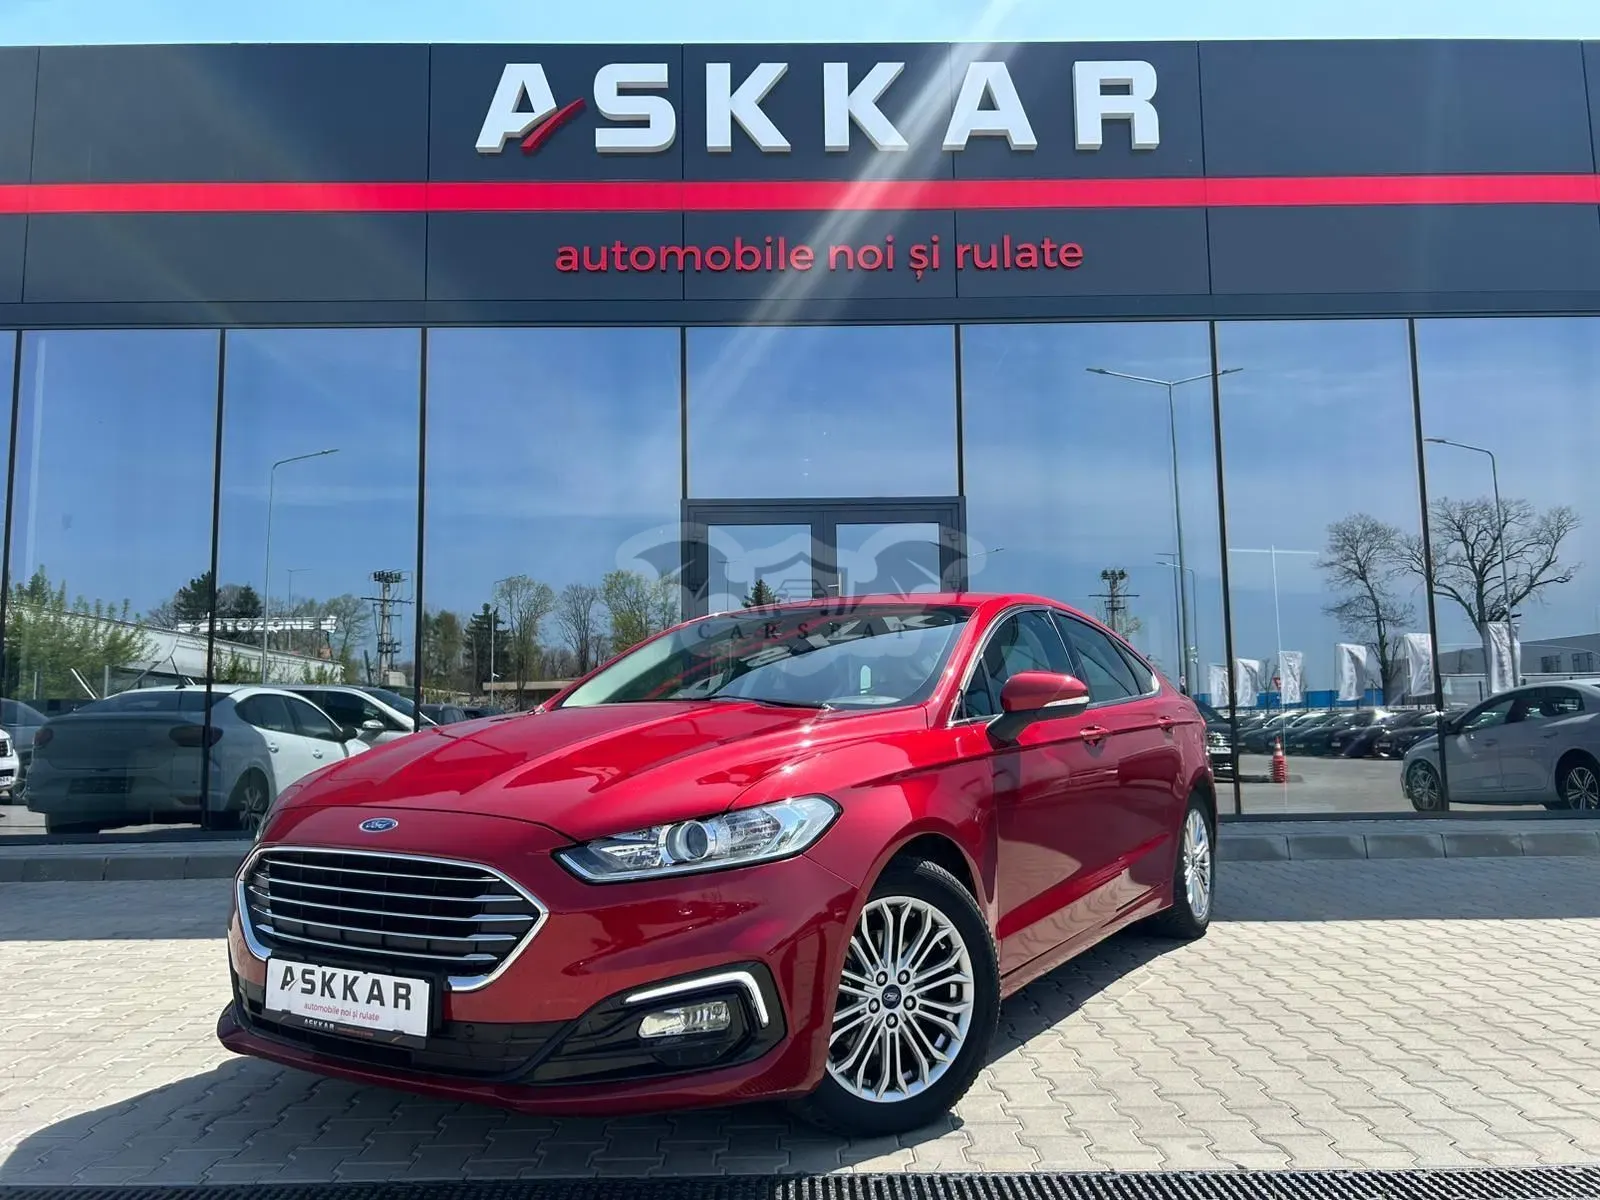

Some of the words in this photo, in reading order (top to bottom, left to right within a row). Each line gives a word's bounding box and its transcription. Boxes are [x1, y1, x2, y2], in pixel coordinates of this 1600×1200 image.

[475, 60, 1160, 154] ASKKAR
[555, 236, 815, 272] automobile
[829, 234, 895, 271] noi
[909, 234, 940, 281] și
[956, 234, 1084, 270] rulate
[280, 966, 411, 1010] ASKKAR
[304, 1002, 339, 1015] automobile
